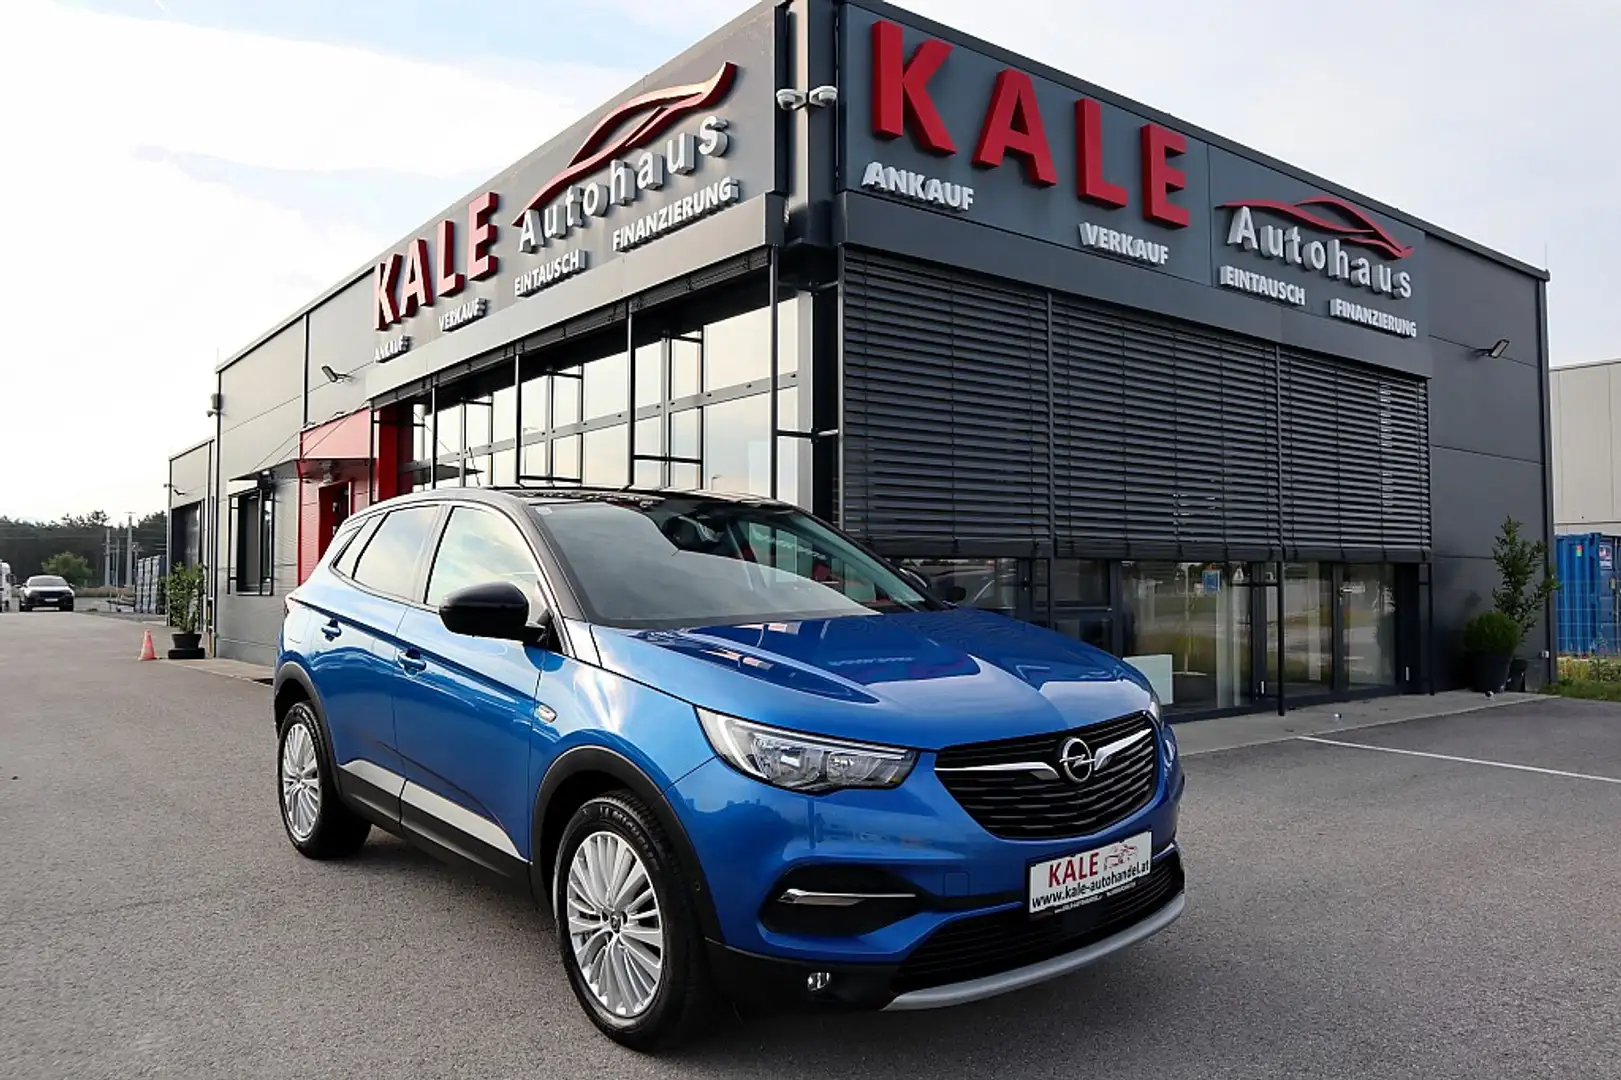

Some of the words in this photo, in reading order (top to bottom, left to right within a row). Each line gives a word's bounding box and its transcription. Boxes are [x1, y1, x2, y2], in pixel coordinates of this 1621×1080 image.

[870, 20, 1191, 229] KALE
[518, 116, 728, 253] Autohaus
[862, 161, 974, 211] ANKAUF
[612, 177, 741, 252] FINANZIERUNG
[374, 191, 500, 331] KALE
[1079, 222, 1169, 266] VERKAUF
[1227, 206, 1412, 299] Autohaus
[514, 249, 588, 297] EINTAUSCH
[1220, 265, 1306, 306] EINTAUSCH
[438, 298, 487, 332] VERKAUF
[1329, 298, 1417, 338] FINANZIERUNG
[1032, 860, 1149, 908] www.kale-autohandel.at
[1048, 852, 1100, 888] KALE
